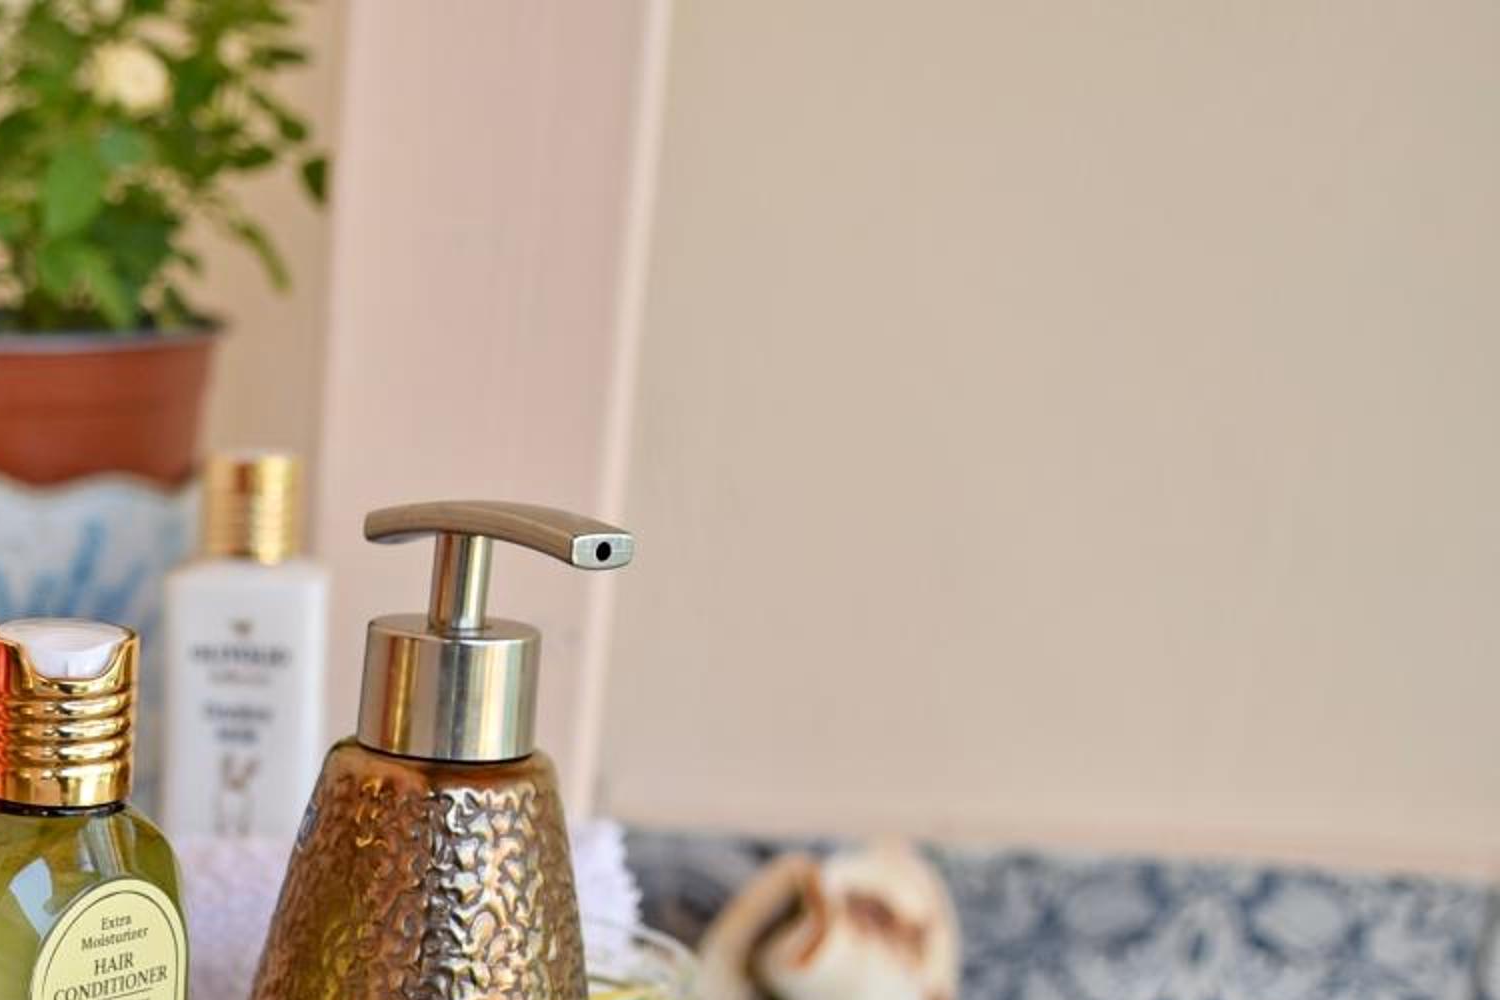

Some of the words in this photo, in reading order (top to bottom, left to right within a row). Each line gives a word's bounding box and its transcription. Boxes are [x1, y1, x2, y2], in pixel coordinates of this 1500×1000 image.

[101, 915, 132, 930] Extra
[81, 927, 149, 950] Moisturizer
[94, 951, 134, 976] HAIR
